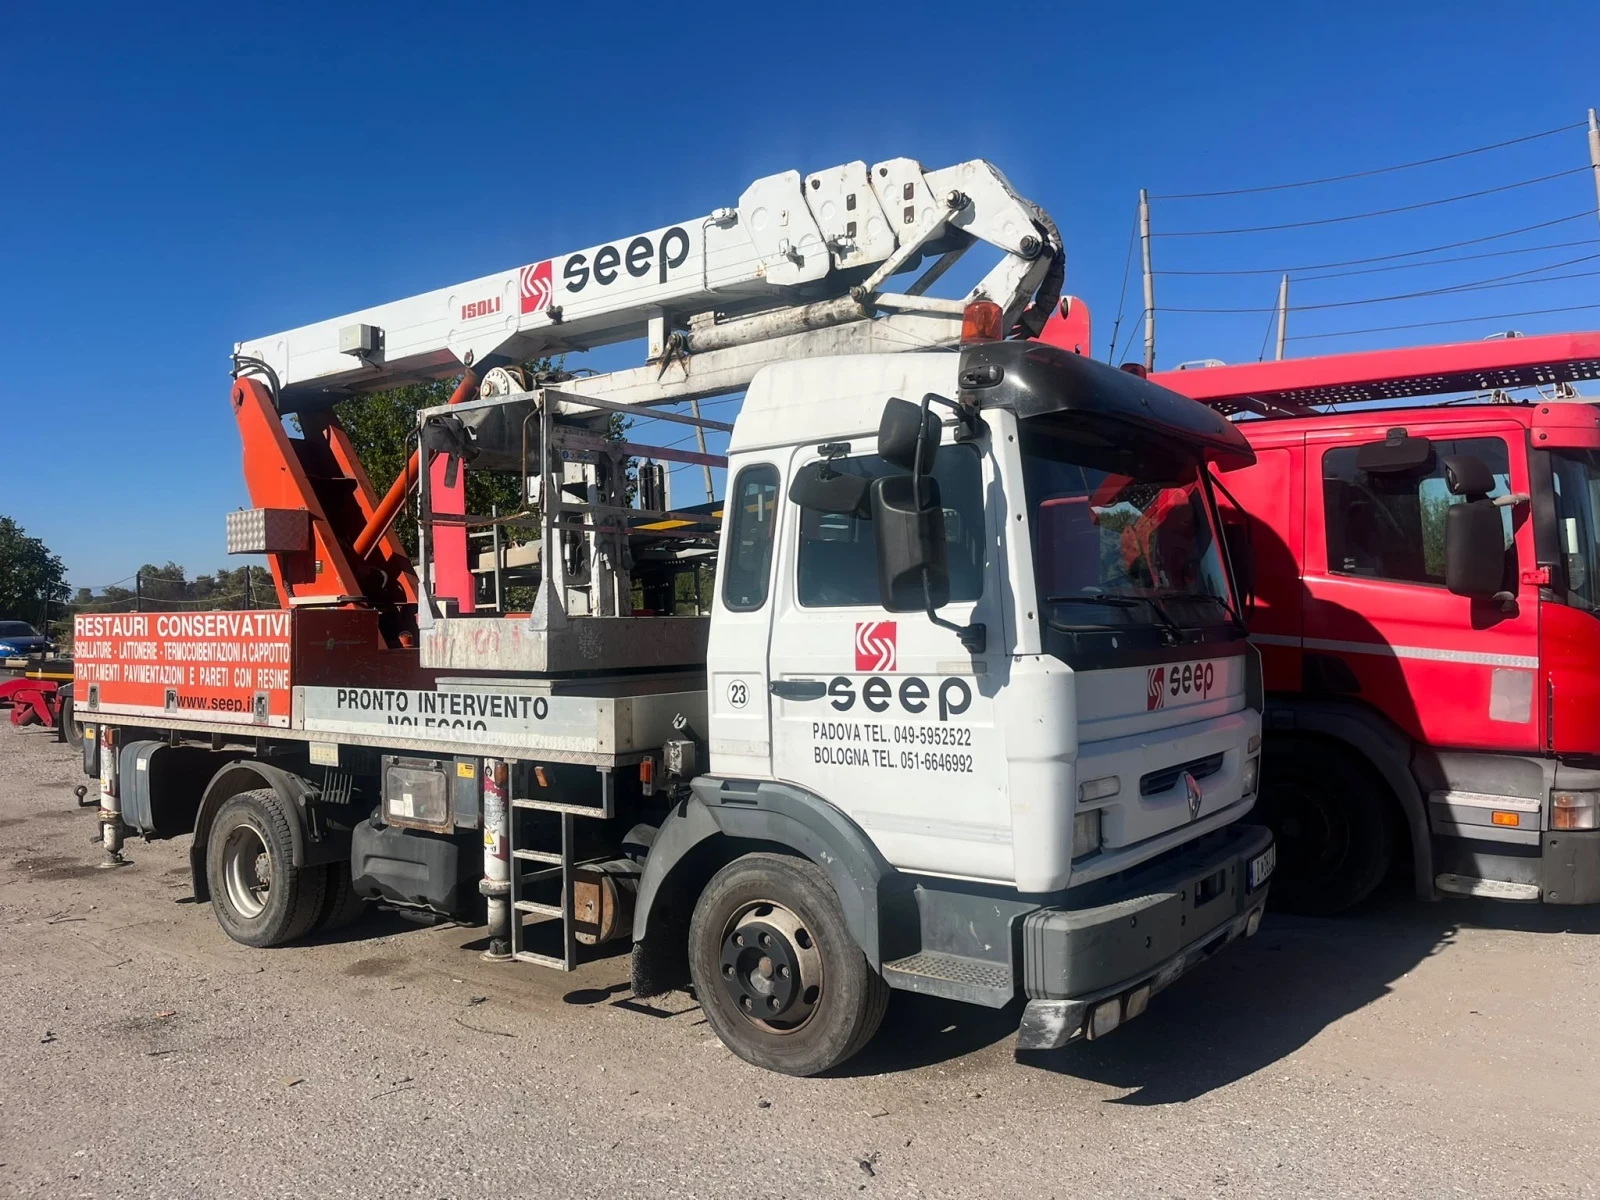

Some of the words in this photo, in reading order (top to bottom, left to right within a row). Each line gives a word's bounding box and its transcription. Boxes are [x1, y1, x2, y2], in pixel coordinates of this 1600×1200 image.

[563, 226, 690, 293] seep
[461, 296, 500, 321] ISOLI
[75, 616, 149, 637] RESTAURI
[157, 614, 289, 637] CONSERVATIVI
[75, 641, 112, 659] SIGILLATURE
[119, 641, 157, 660] LATTONERIE
[164, 641, 240, 662] TERMOCOIBENTAZIONI
[241, 643, 248, 662] A
[248, 642, 289, 664] CAPPOTTO
[75, 663, 120, 682] TRATTAMENTI
[124, 664, 185, 685] PAVIMENTAZIONI
[189, 667, 195, 686] E
[199, 667, 228, 687] PARETI
[234, 668, 252, 688] CON
[258, 668, 289, 690] RESINE
[1169, 662, 1214, 700] seep
[337, 688, 409, 712] PRONTO
[418, 692, 548, 720] INTERVENTO
[731, 684, 746, 704] 23
[827, 676, 972, 721] seep
[813, 722, 861, 742] PADOVA
[864, 724, 891, 743] TEL.
[894, 725, 972, 747] 049-5952522
[814, 746, 870, 766] BOLOGNA
[873, 749, 898, 768] TEL.
[900, 751, 974, 773] 051-6646992
